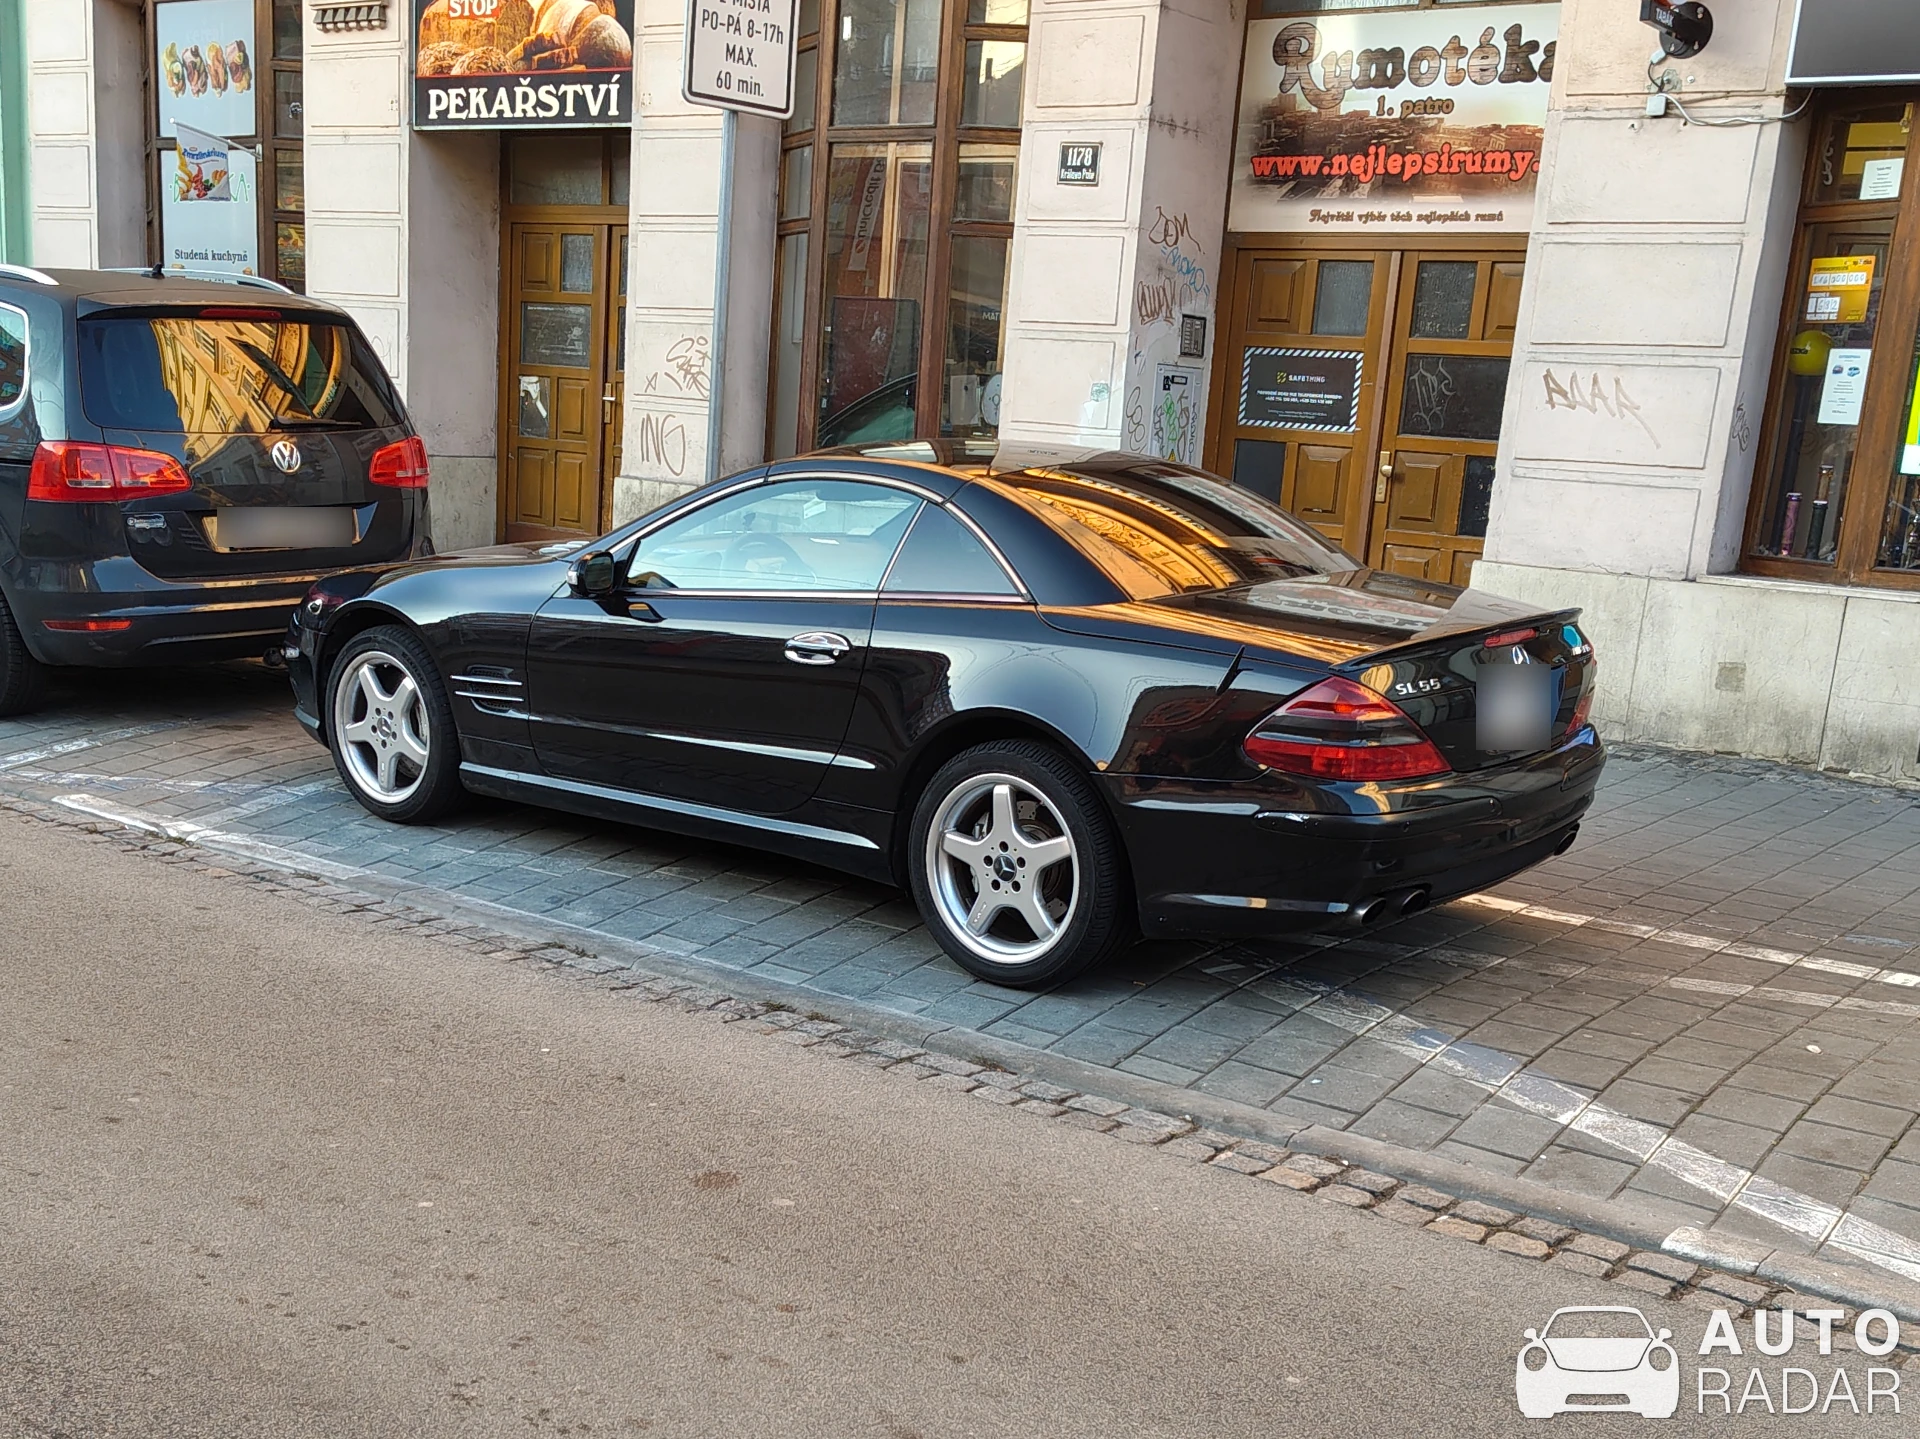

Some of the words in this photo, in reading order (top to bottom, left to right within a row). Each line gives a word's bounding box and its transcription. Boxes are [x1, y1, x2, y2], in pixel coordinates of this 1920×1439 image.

[449, 0, 498, 17] STOP
[1656, 7, 1675, 28] TABÁK
[702, 9, 742, 36] PO-PÁ
[747, 19, 784, 45] 8-17h
[725, 43, 758, 68] MAX.
[716, 70, 732, 90] 60
[737, 76, 765, 97] min.
[428, 74, 621, 120] PEKAŘSTVÍ
[1400, 96, 1455, 120] patro
[1066, 147, 1093, 167] 1178
[174, 248, 209, 261] Studená
[211, 249, 248, 264] kuchyně
